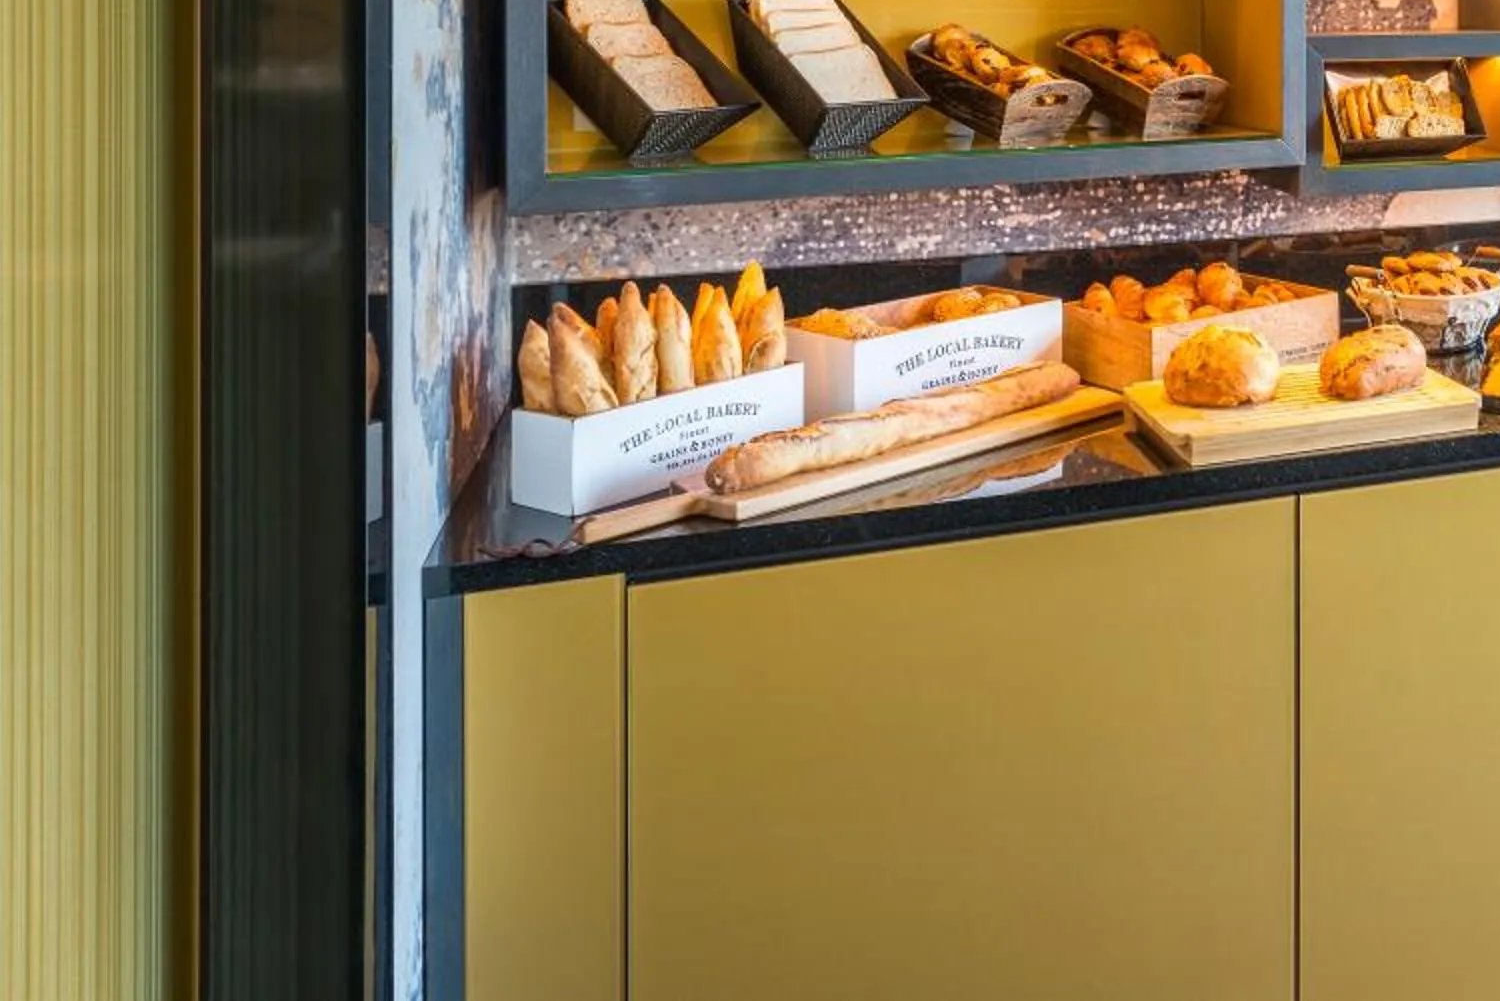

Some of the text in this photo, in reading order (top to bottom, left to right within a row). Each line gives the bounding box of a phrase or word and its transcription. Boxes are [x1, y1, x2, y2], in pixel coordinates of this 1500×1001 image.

[895, 334, 1025, 376] THE LOCAL BAKERY
[619, 402, 762, 454] THE LOCAL BAKERY
